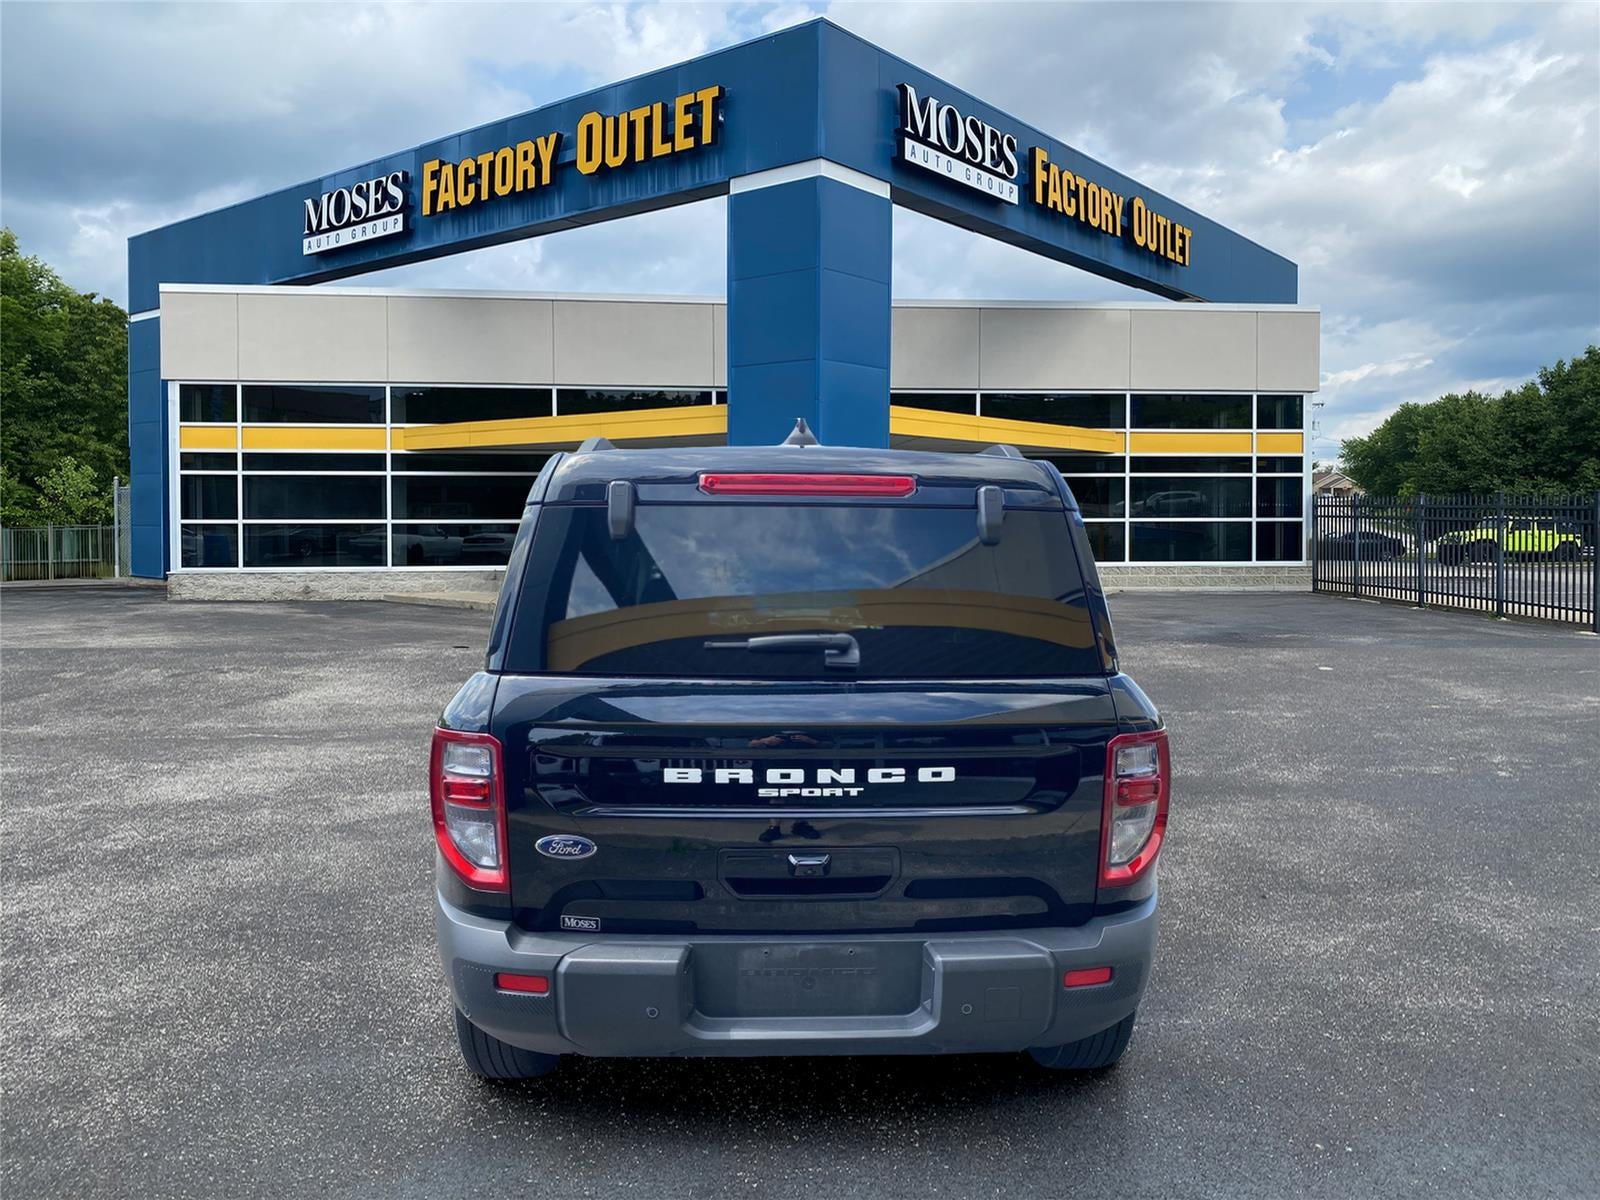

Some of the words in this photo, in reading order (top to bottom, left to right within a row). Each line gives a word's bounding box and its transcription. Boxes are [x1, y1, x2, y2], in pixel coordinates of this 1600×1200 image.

[421, 132, 559, 216] FACTORY
[576, 85, 721, 176] OUTLET
[903, 83, 1019, 179] MOSES
[910, 144, 953, 173] AUTO
[965, 167, 1014, 198] GROUP
[303, 171, 404, 234] MOSES
[1034, 146, 1124, 238] FACTORY
[1132, 197, 1192, 267] OUTLET
[307, 233, 340, 251] AUTO
[351, 217, 399, 240] GROUP
[663, 766, 956, 784] BRONCO
[757, 787, 865, 797] SPORT
[548, 840, 582, 855] Ford
[564, 917, 597, 929] MOSES
